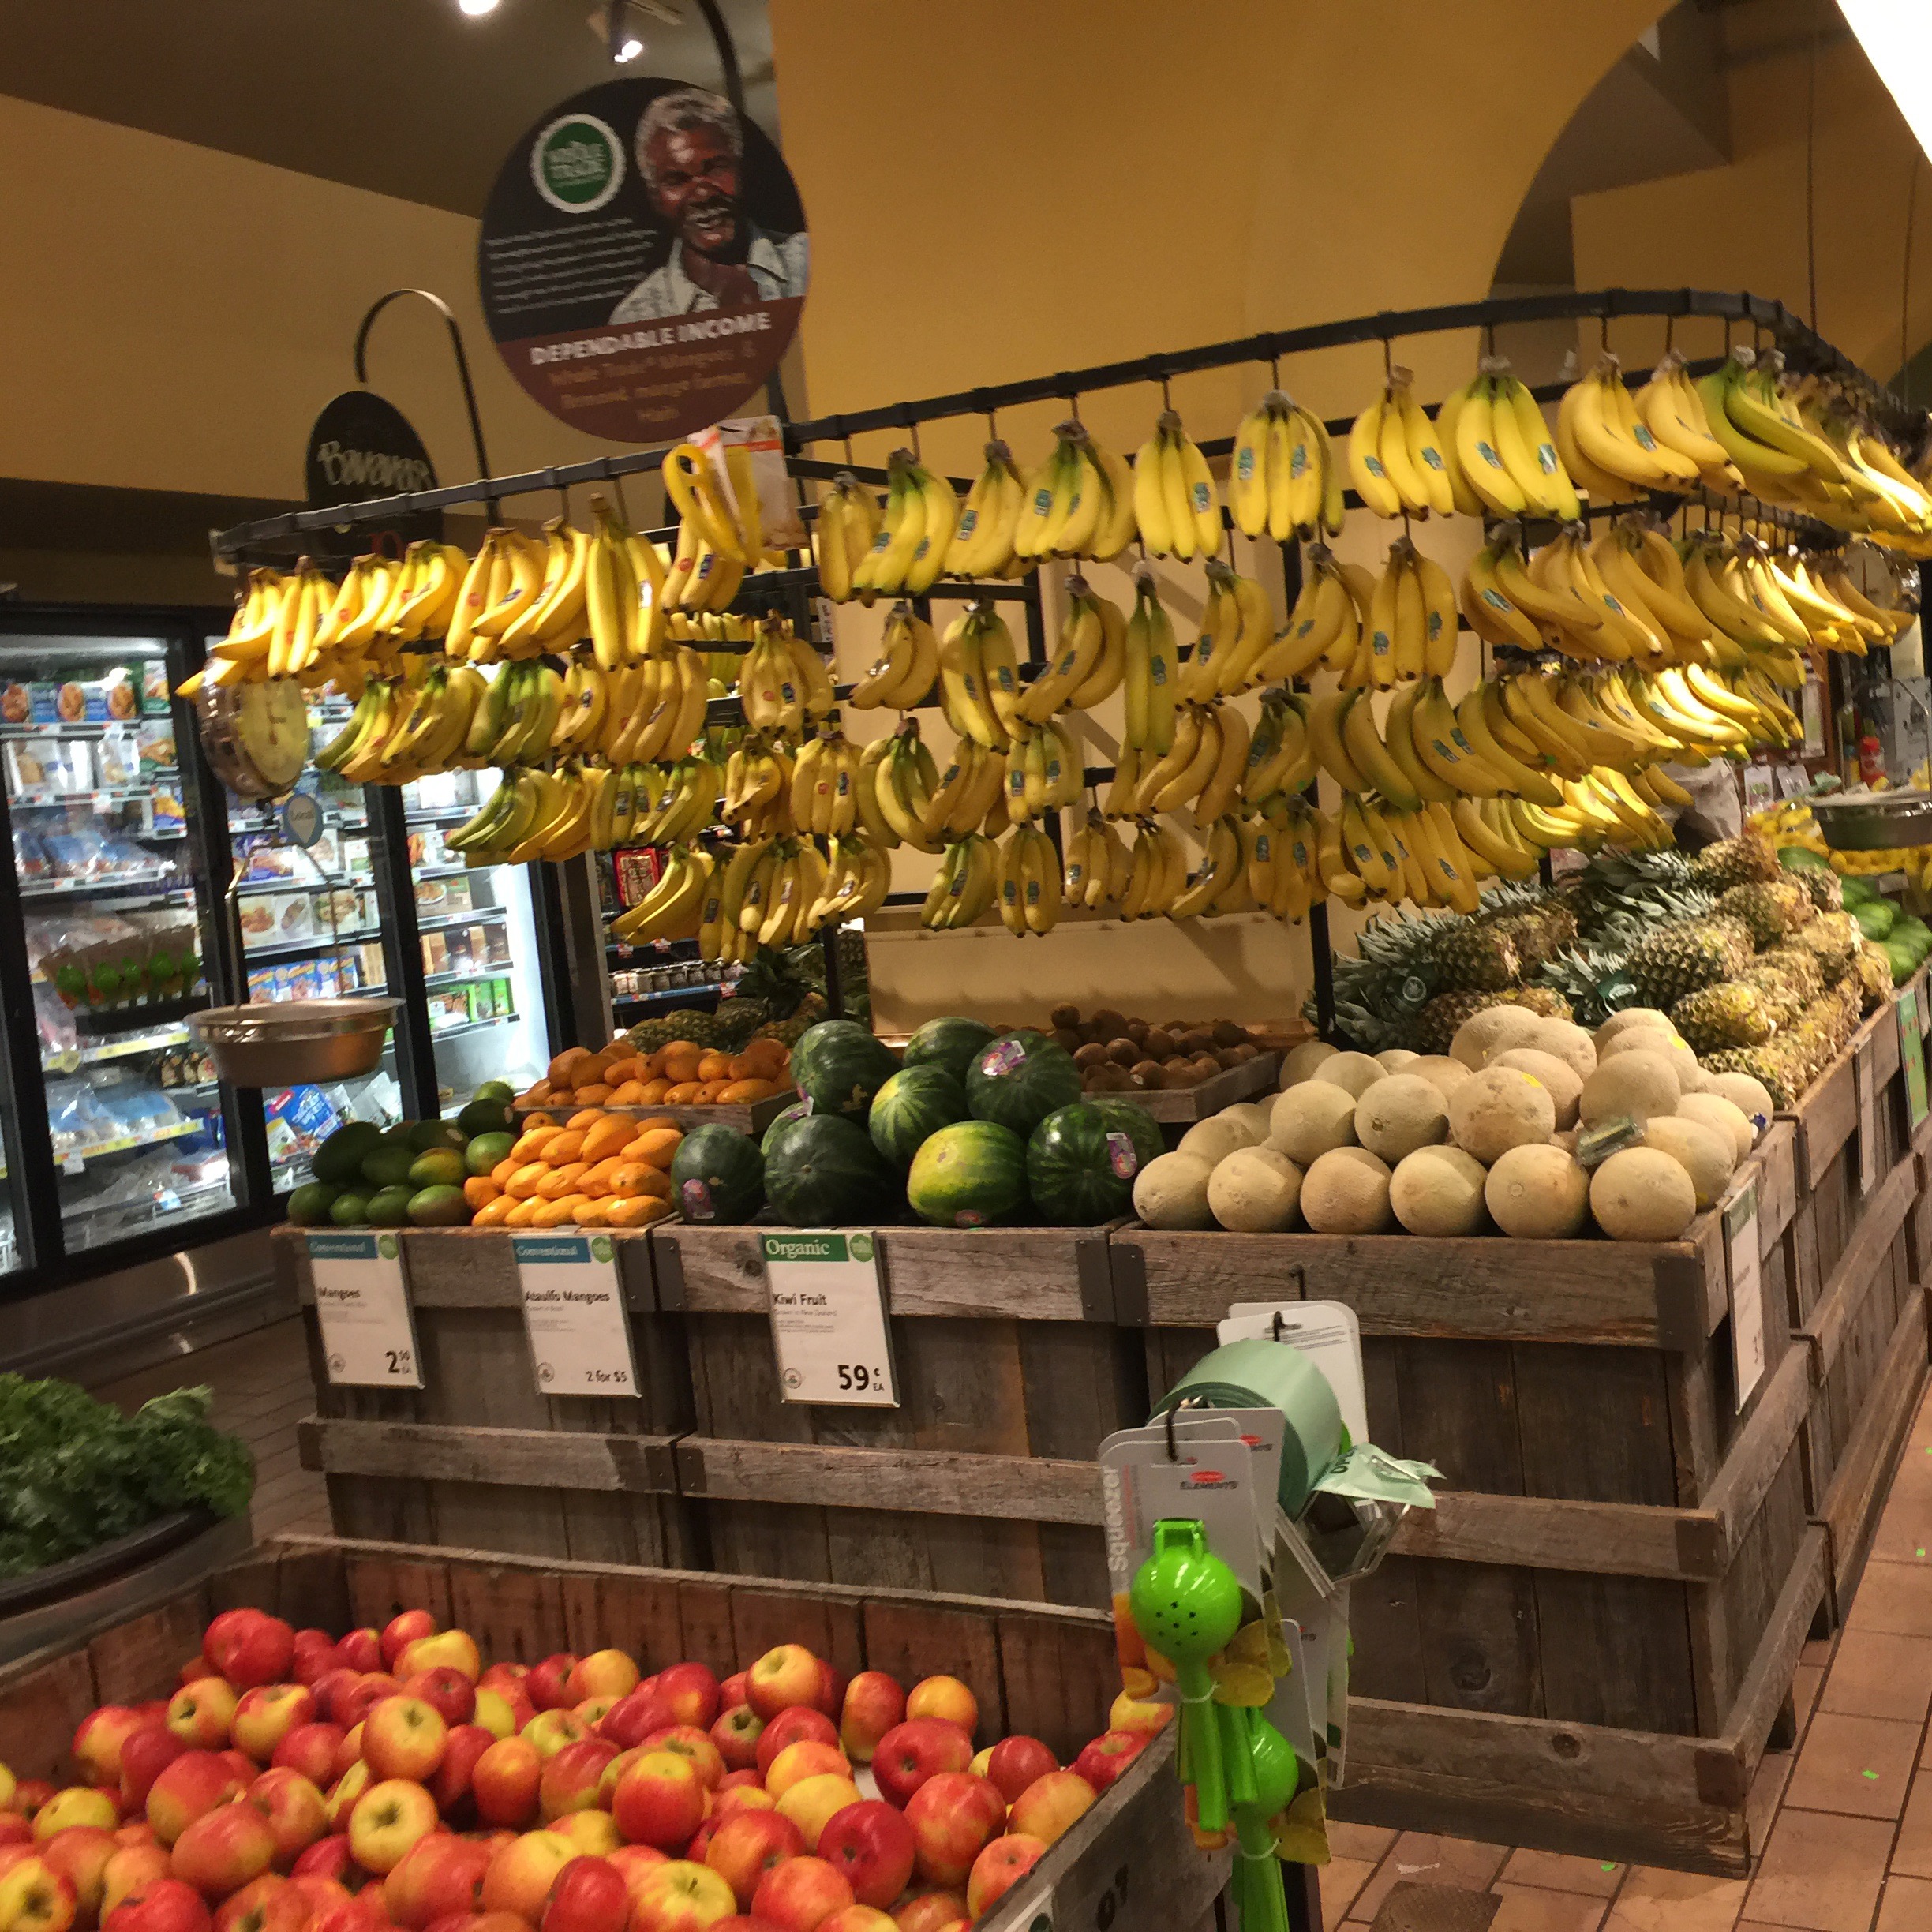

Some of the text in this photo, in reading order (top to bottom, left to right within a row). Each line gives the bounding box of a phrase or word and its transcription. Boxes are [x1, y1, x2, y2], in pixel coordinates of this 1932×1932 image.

[677, 312, 772, 343] INCOME
[765, 1239, 830, 1260] Organic
[316, 1286, 361, 1301] Mangoes
[563, 1290, 610, 1305] Mangoes
[773, 1292, 827, 1306] Kiwi Fruit
[586, 1370, 593, 1382] 2
[837, 1365, 870, 1391] 59
